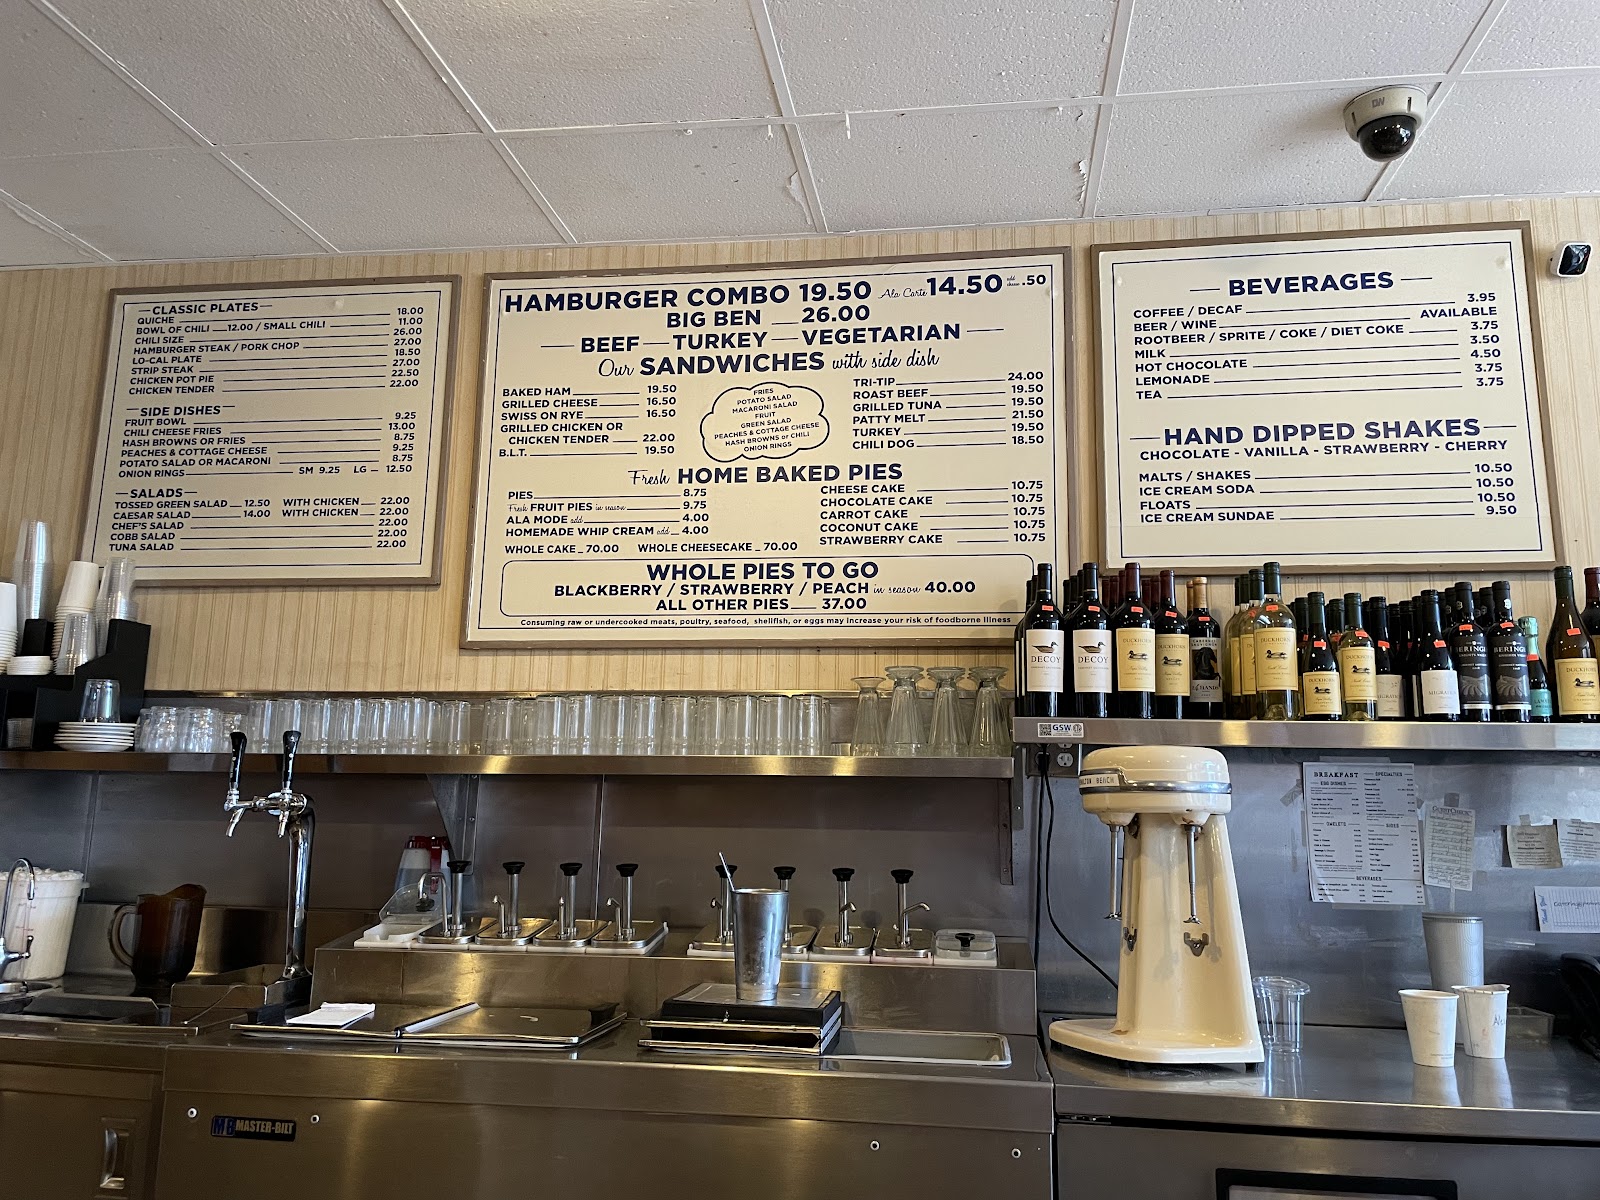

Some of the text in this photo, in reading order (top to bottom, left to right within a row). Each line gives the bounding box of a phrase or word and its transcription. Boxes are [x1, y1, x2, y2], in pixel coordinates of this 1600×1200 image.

[1229, 272, 1393, 296] BEVERAGES
[505, 290, 678, 312] HAMBURGER
[687, 285, 789, 306] COMBO
[799, 281, 871, 302] 19.50
[878, 289, 900, 298] Ala
[902, 288, 928, 298] Carte
[927, 274, 1002, 295] 14.50
[1022, 274, 1046, 286] .50
[138, 307, 424, 324] QUICHE 18.00
[152, 302, 258, 315] CLASSIC PLATES
[667, 305, 870, 328] BIG BEN 26.00
[393, 328, 422, 336] 26.00
[581, 324, 960, 352] BEEF TURKEY VEGETARIAN
[1135, 335, 1499, 358] MILK 3.50
[599, 348, 940, 377] Our SANDWICHES with side dish
[1136, 349, 1500, 372] HOT CHOCOLATE 4.50
[1136, 363, 1502, 386] LEMONADE 3.75
[1136, 377, 1504, 399] TEA 3.75
[732, 401, 797, 414] MACARONI SALAD
[737, 394, 792, 405] POTATO SALAD
[140, 406, 220, 416] SIDE DISHES
[395, 412, 416, 420] 9.25
[714, 431, 747, 440] PEACHES
[756, 426, 789, 434] COTTAGE
[791, 422, 820, 430] CHEESE
[741, 421, 765, 429] GREEN
[1165, 418, 1480, 445] HAND DIPPED SHAKES
[747, 435, 779, 444] BROWNS
[118, 470, 152, 478] ONION
[319, 466, 340, 474] 9.25
[628, 463, 902, 485] Fresh HOME BAKED PIES
[130, 488, 183, 498] SALADS
[1140, 478, 1514, 496] ICE CREAM SODA 10.50
[1140, 492, 1515, 510] FLOATS 10.50
[113, 511, 154, 519] CAESAR
[156, 511, 190, 519] SALAD
[282, 509, 309, 517] WITH
[312, 508, 358, 516] CHICKEN
[1141, 506, 1516, 523] ICE CREAM SUNDAE 9.50
[110, 529, 407, 541] COBB SALAD 22.00
[140, 543, 174, 551] SALAD
[376, 540, 406, 548] 22.00
[647, 562, 878, 580] WHOLE PIES TO GO
[650, 618, 678, 626] meats,
[680, 618, 711, 626] poultry,
[906, 616, 922, 624] risk
[924, 616, 934, 624] of
[935, 616, 981, 624] foodborne
[1078, 656, 1109, 664] DECOY
[235, 1120, 294, 1134] MASTER-BILT
